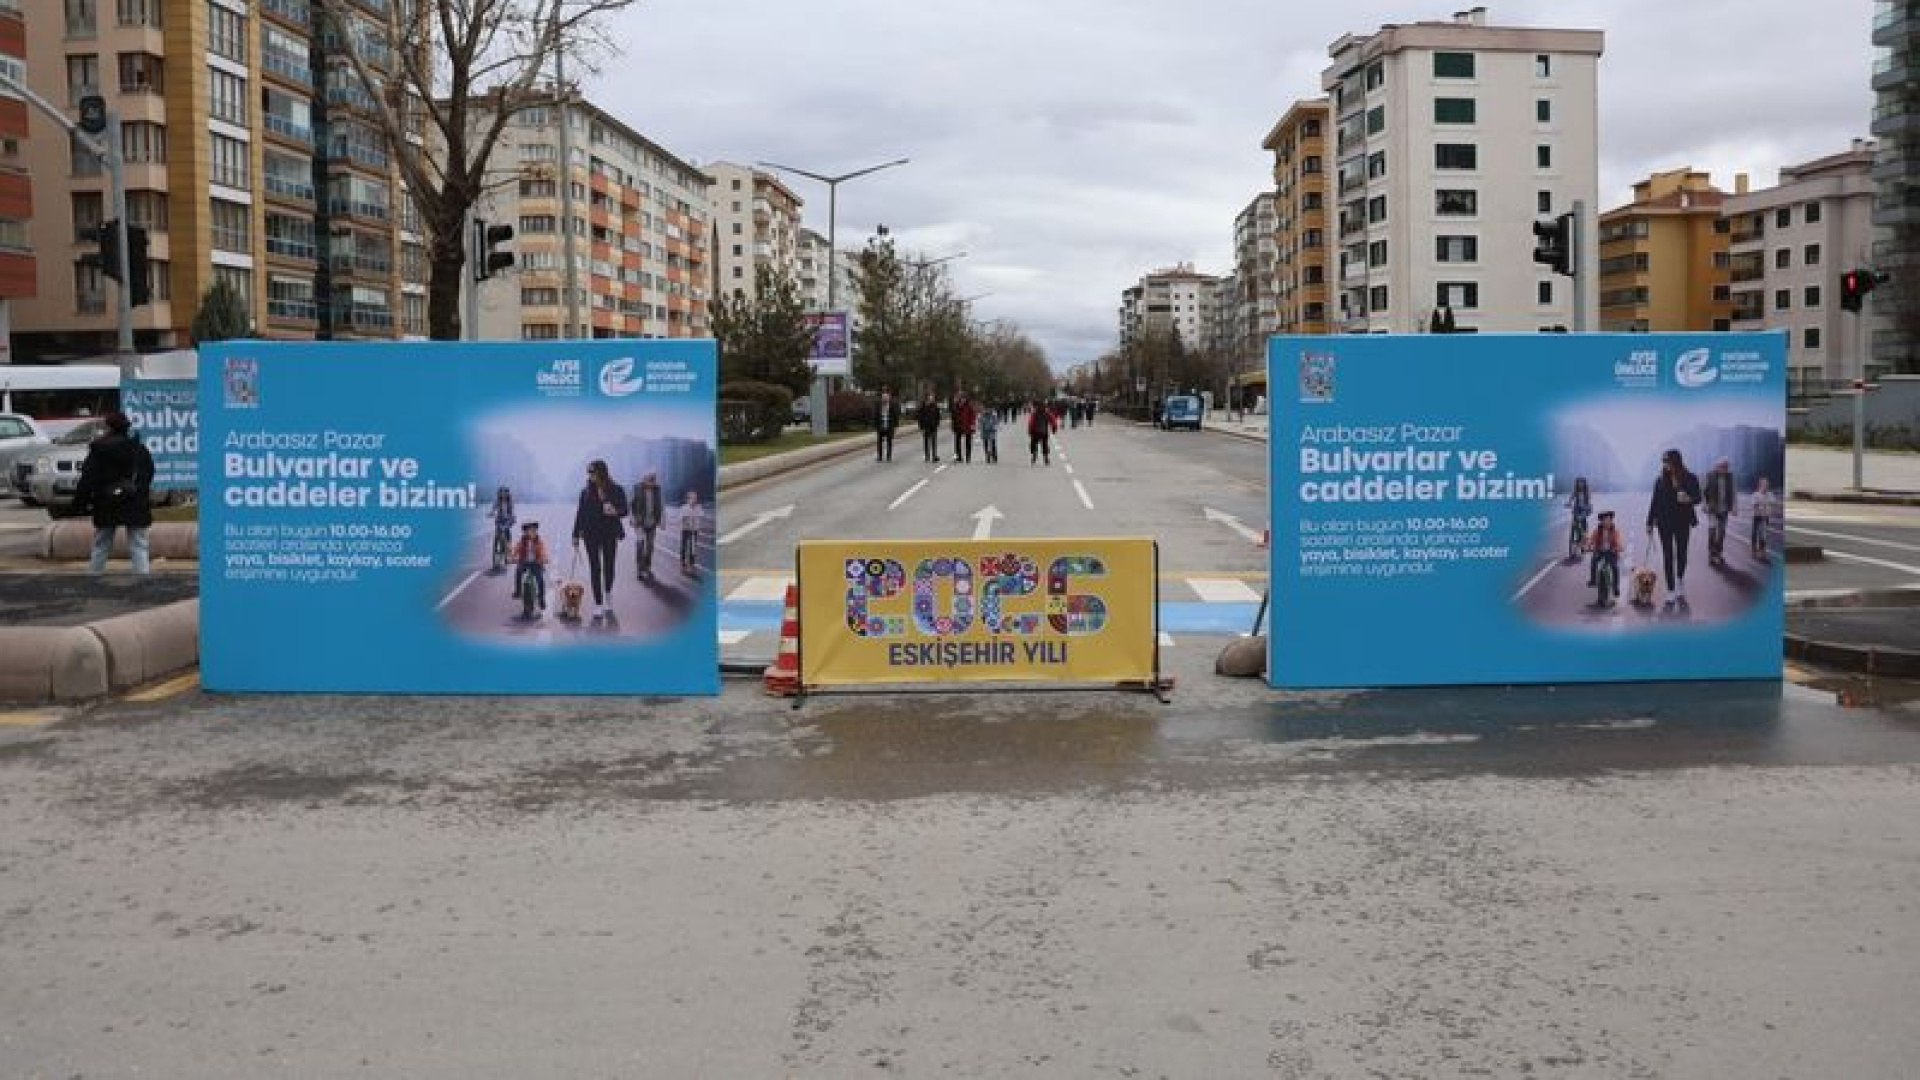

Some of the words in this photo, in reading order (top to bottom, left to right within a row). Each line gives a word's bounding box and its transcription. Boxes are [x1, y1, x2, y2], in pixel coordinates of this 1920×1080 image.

[146, 431, 199, 452] add
[225, 430, 318, 450] Arabasız
[324, 430, 385, 450] Pazar
[1300, 424, 1395, 443] Arabasız
[1401, 423, 1463, 443] Pazar
[225, 451, 374, 478] Bulvarlar
[380, 457, 419, 478] ve
[1300, 446, 1451, 473] Bulvarlar
[1458, 450, 1498, 471] ve
[225, 479, 370, 507] caddeler
[380, 479, 477, 507] bizim!
[1300, 475, 1449, 502] caddeler
[1457, 472, 1554, 501] bizim!
[225, 523, 243, 536] Bu
[247, 524, 278, 537] alan
[330, 524, 412, 538] 10.00-16.00
[1300, 518, 1319, 532] Bu
[1323, 518, 1353, 531] alan
[1406, 516, 1489, 530] 10.00-16.00
[844, 554, 1107, 637] 2026
[888, 636, 1014, 668] ESKİŞEHİR
[1023, 641, 1068, 665] YILI
